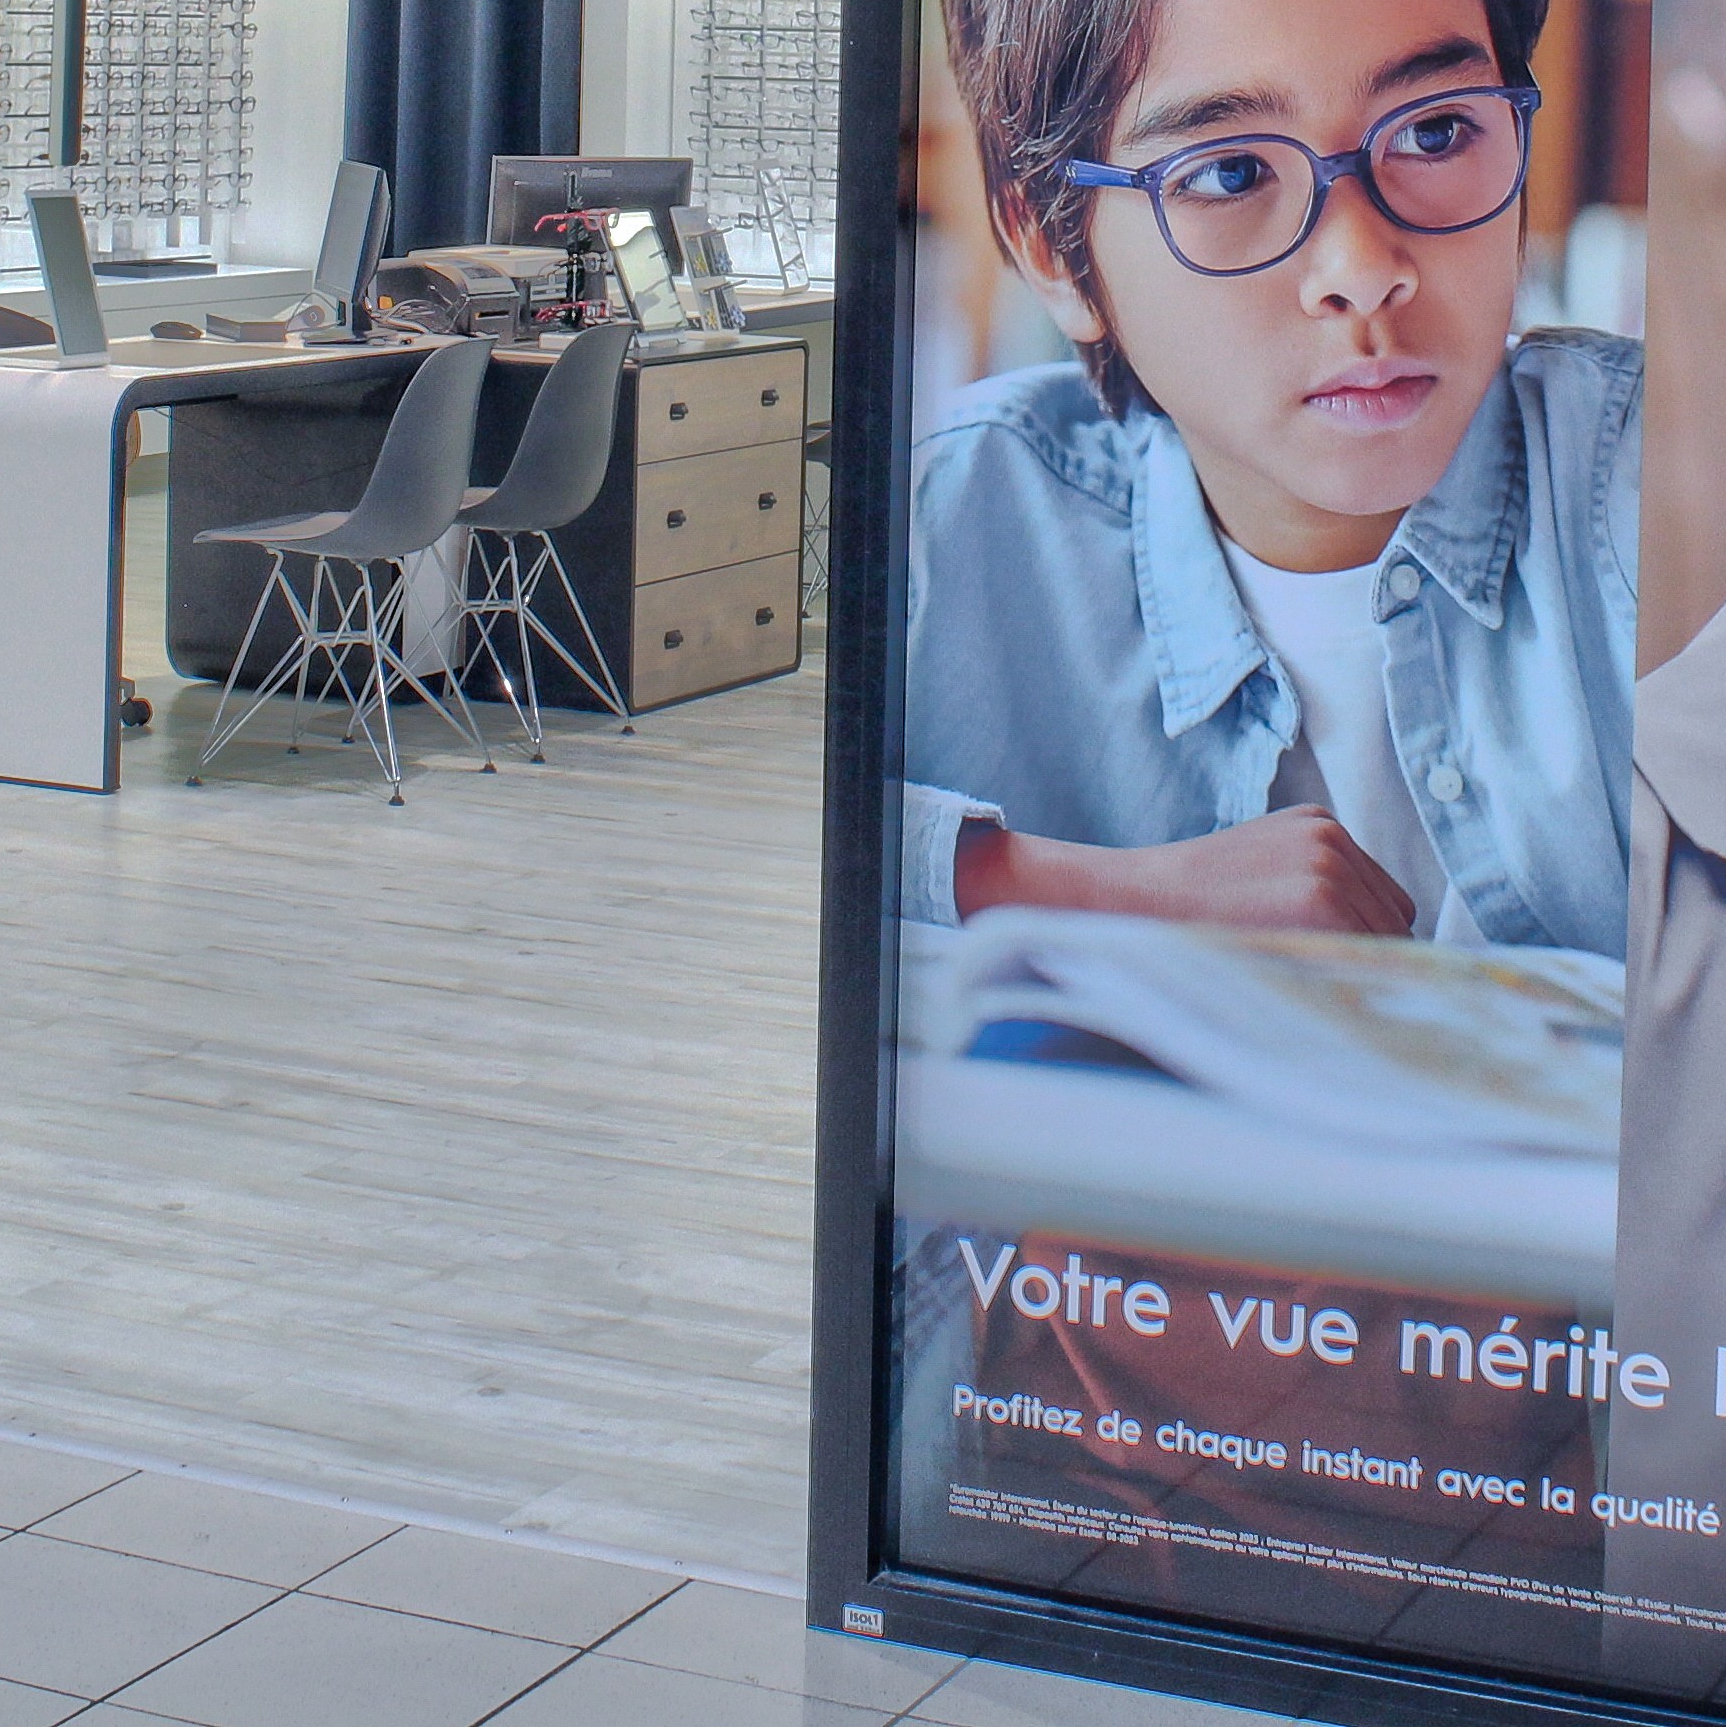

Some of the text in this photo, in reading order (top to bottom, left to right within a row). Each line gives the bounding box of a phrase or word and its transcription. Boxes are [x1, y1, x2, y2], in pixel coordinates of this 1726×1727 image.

[956, 1237, 1173, 1338] Votre
[1207, 1291, 1361, 1365] vue
[1398, 1314, 1672, 1409] mérite
[951, 1382, 1084, 1438] Profitez
[1096, 1410, 1143, 1448] de
[1154, 1418, 1288, 1471] chaque
[1300, 1439, 1423, 1491] instant
[1435, 1466, 1527, 1509] avec
[1539, 1476, 1577, 1516] la
[1589, 1494, 1721, 1537] qualité
